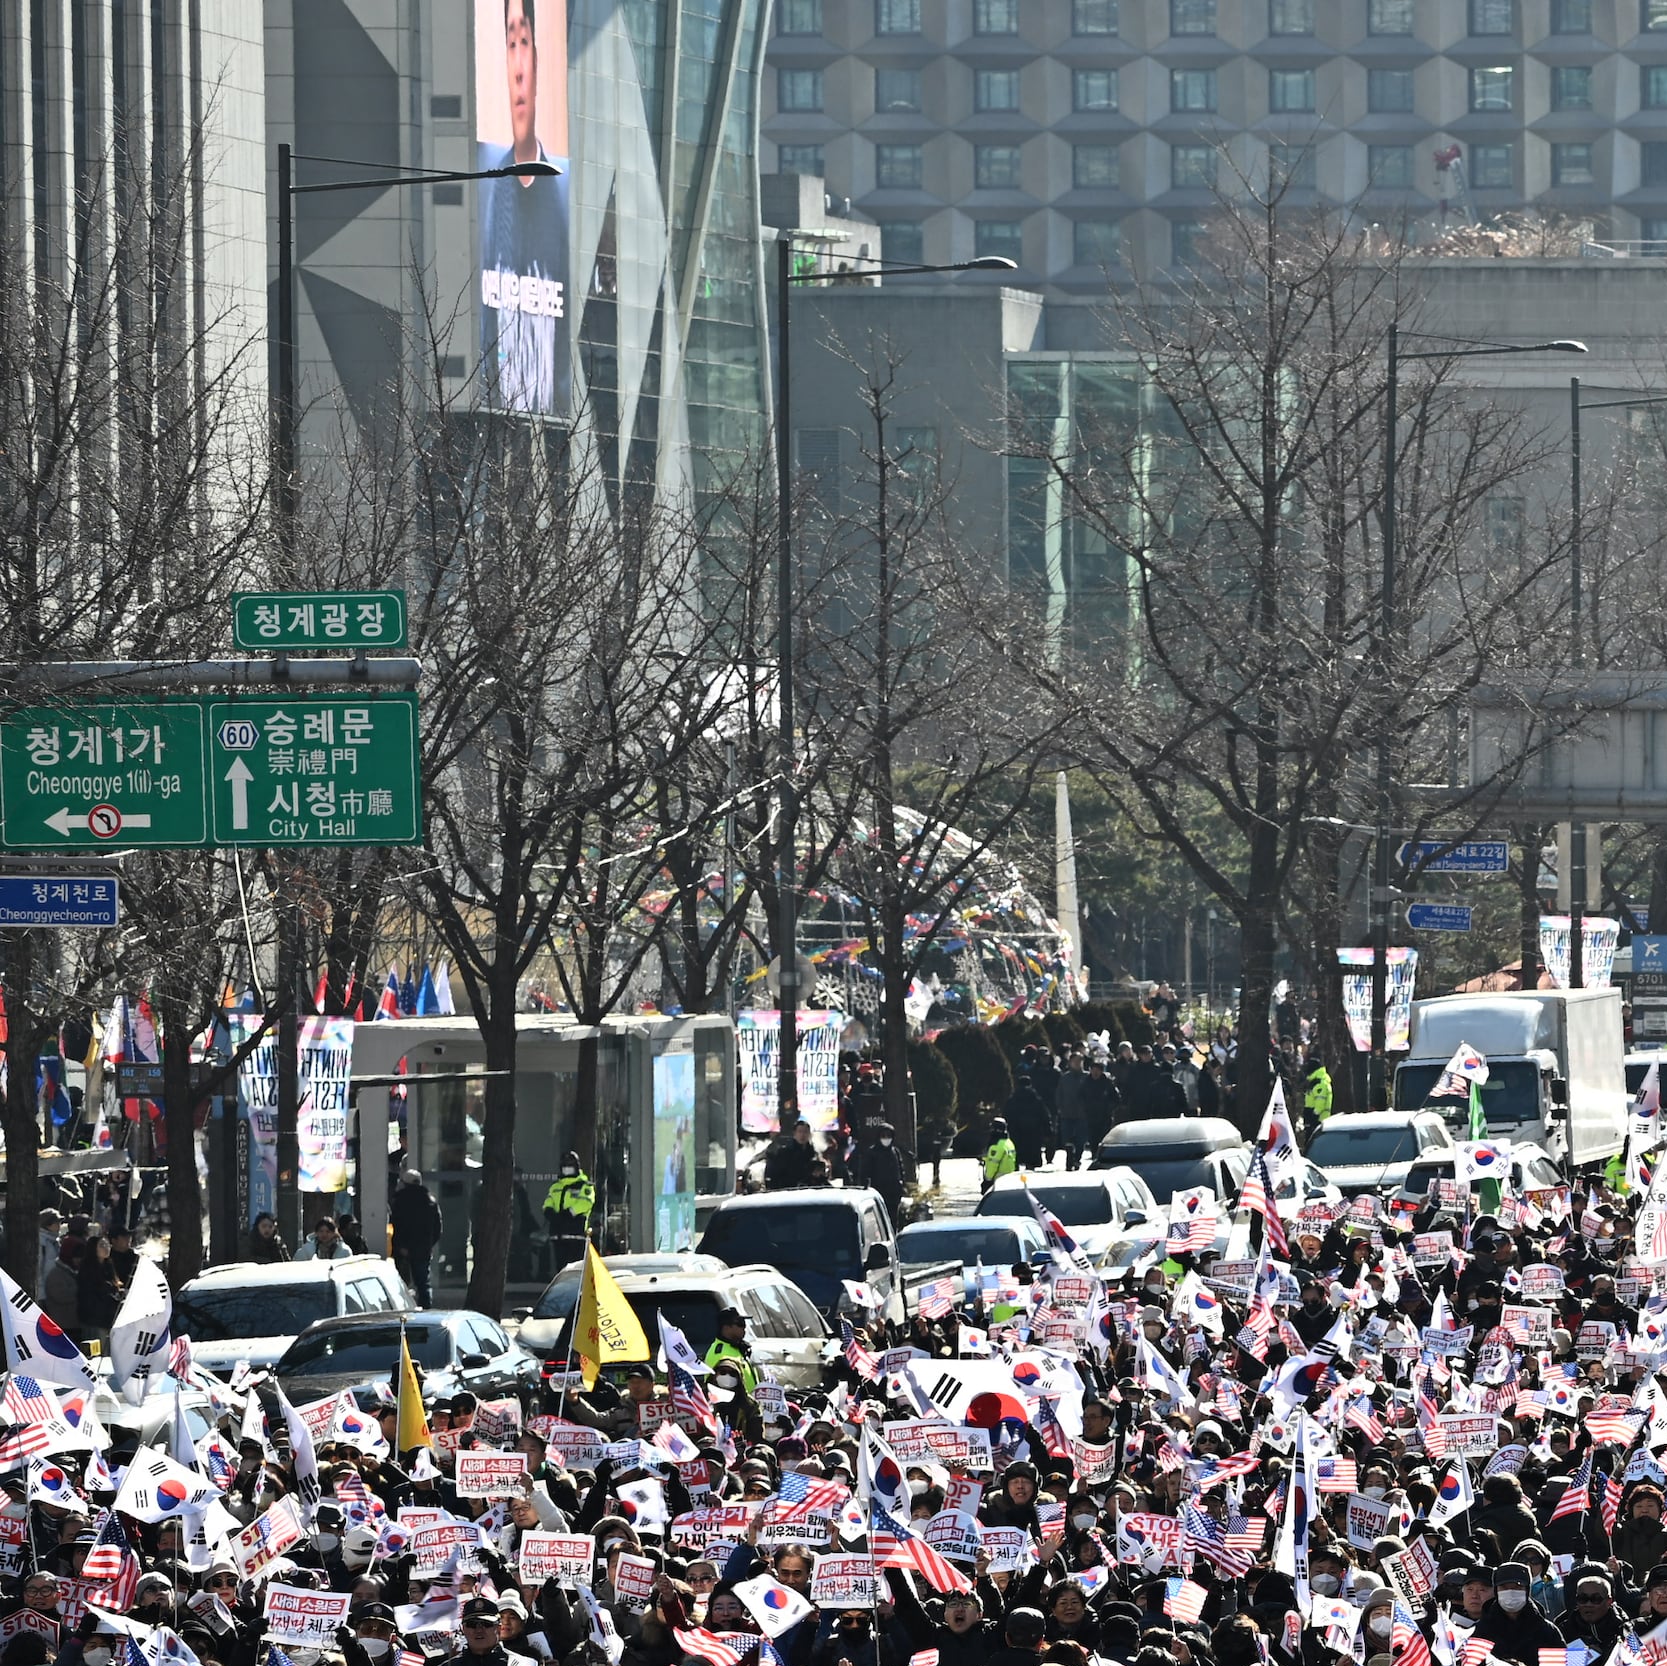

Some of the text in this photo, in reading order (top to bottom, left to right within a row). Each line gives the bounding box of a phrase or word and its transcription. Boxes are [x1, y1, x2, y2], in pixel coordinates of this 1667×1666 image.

[253, 603, 385, 637] 청계광장
[226, 726, 249, 746] 60
[263, 709, 374, 745] 숭례문
[25, 726, 166, 766] 청계1가
[267, 748, 358, 776] 崇禮門
[27, 771, 181, 799] Cheonggye 1(il)-ga
[267, 781, 393, 818] 시청 市廳
[268, 819, 356, 841] City Hall
[31, 884, 110, 904] 청계천로
[0, 907, 110, 923] Cheonggyecheon-ro
[1637, 974, 1663, 984] 6701
[461, 1460, 521, 1473] 새해 소원은
[693, 1522, 723, 1532] OUT
[525, 1541, 588, 1558] 새해 소원은
[820, 1564, 841, 1578] 새해
[272, 1593, 342, 1614] 새해 소원은
